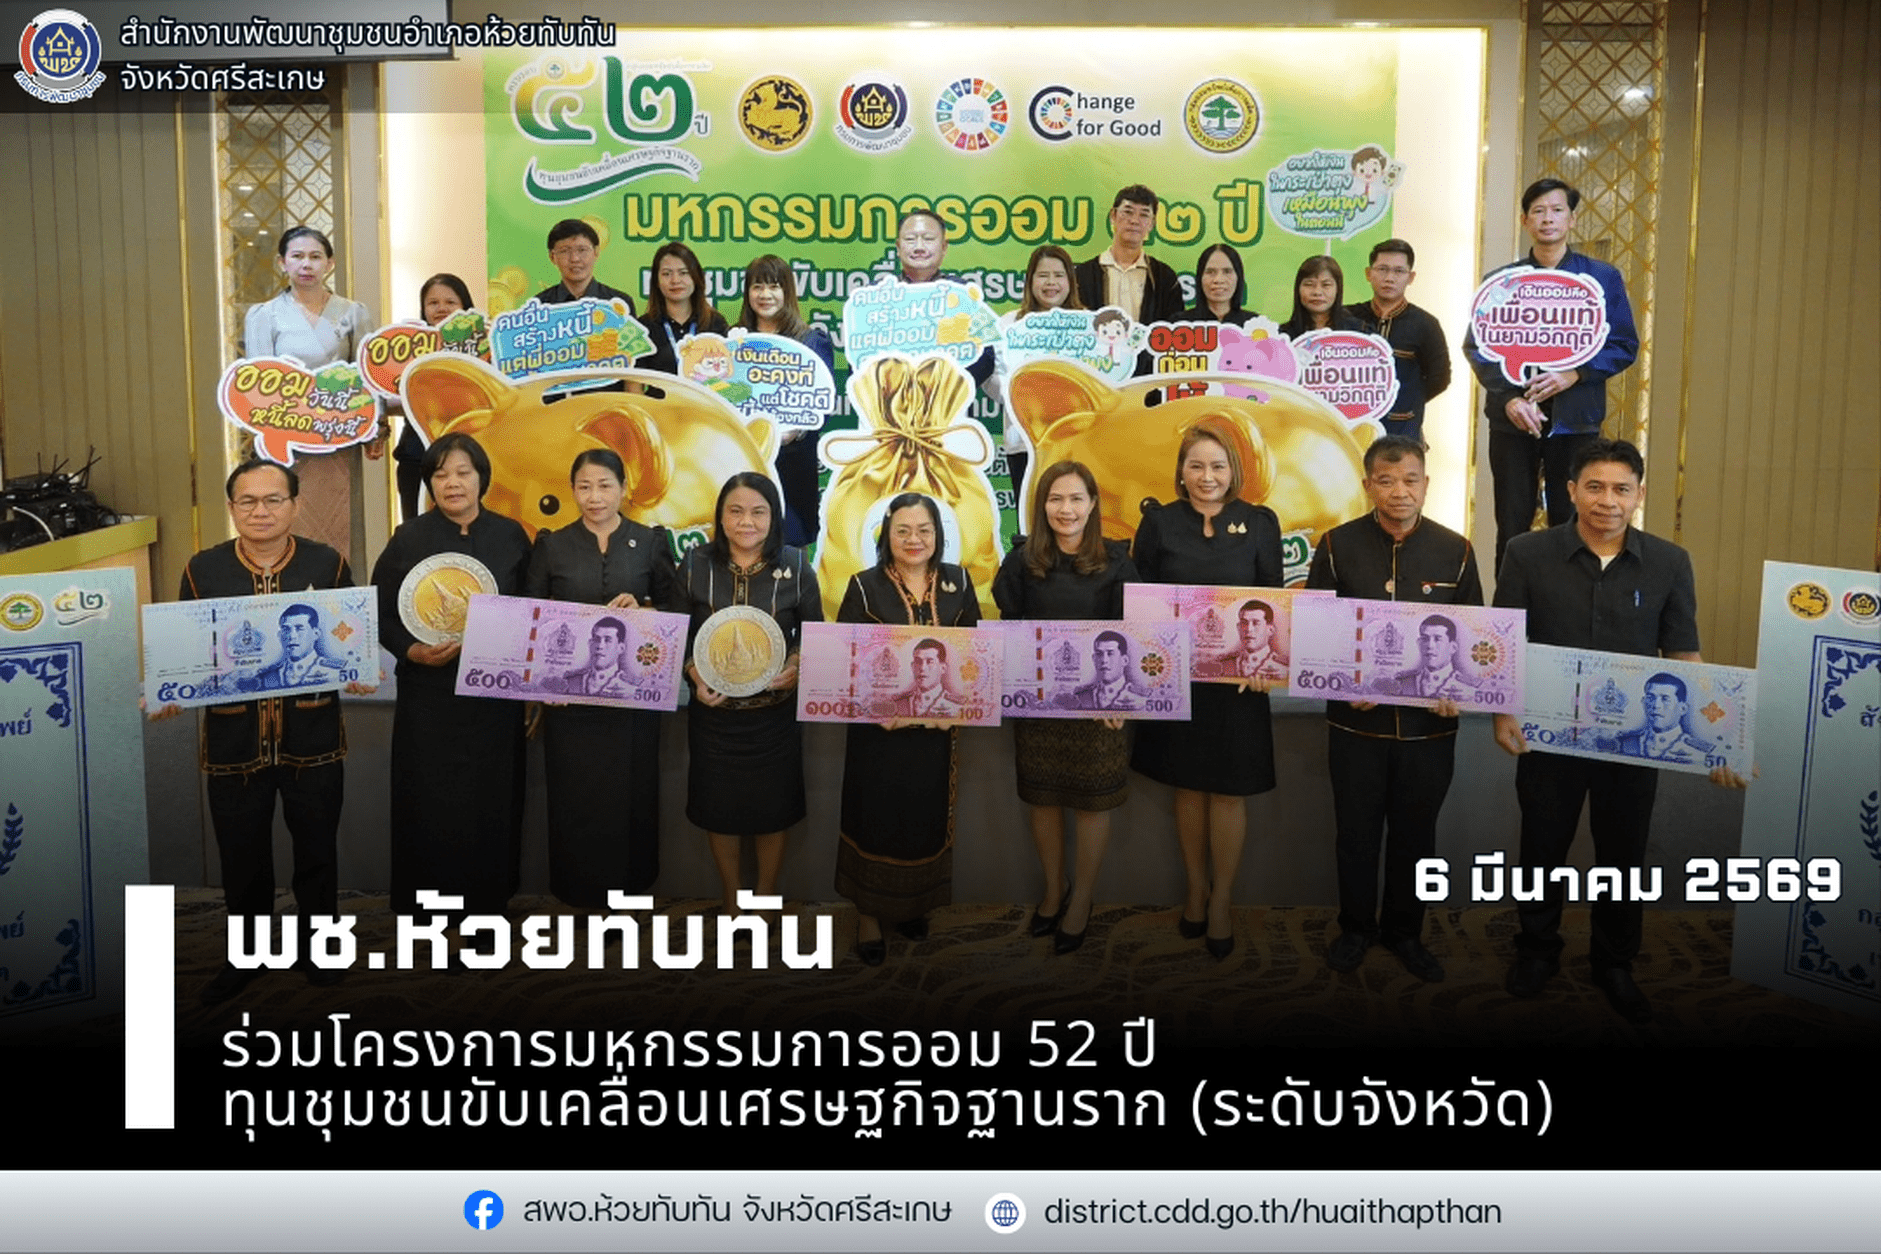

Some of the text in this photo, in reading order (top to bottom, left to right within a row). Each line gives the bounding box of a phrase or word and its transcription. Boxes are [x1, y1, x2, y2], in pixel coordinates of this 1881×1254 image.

[1077, 118, 1162, 136] for Good
[626, 194, 1090, 241] มหกรรมกรออม
[1217, 181, 1261, 244] ปี
[853, 280, 905, 306] คนอื่น
[867, 284, 950, 326] สร้างหนี้
[498, 301, 549, 331] คนอื่น
[1492, 292, 1599, 325] เพื่อนแท้
[513, 303, 595, 349] สร้างหนี้
[1150, 326, 1218, 352] ออม
[1479, 323, 1593, 351] ในยามวิกฤติ
[368, 332, 437, 366] ออม
[500, 342, 585, 374] แต่พี่ออม
[734, 346, 802, 367] เงินเดือน
[1159, 350, 1208, 373] ก่อน
[235, 363, 312, 400] ออม
[748, 361, 815, 387] อะคงที่
[760, 385, 831, 410] แต่โชคดี
[338, 667, 359, 683] 50
[465, 667, 511, 691] ๕๐๐
[1297, 669, 1342, 691] ๕๐๐
[634, 687, 662, 703] 500
[1145, 700, 1173, 712] 500
[1475, 690, 1505, 704] 500
[959, 707, 984, 720] 100
